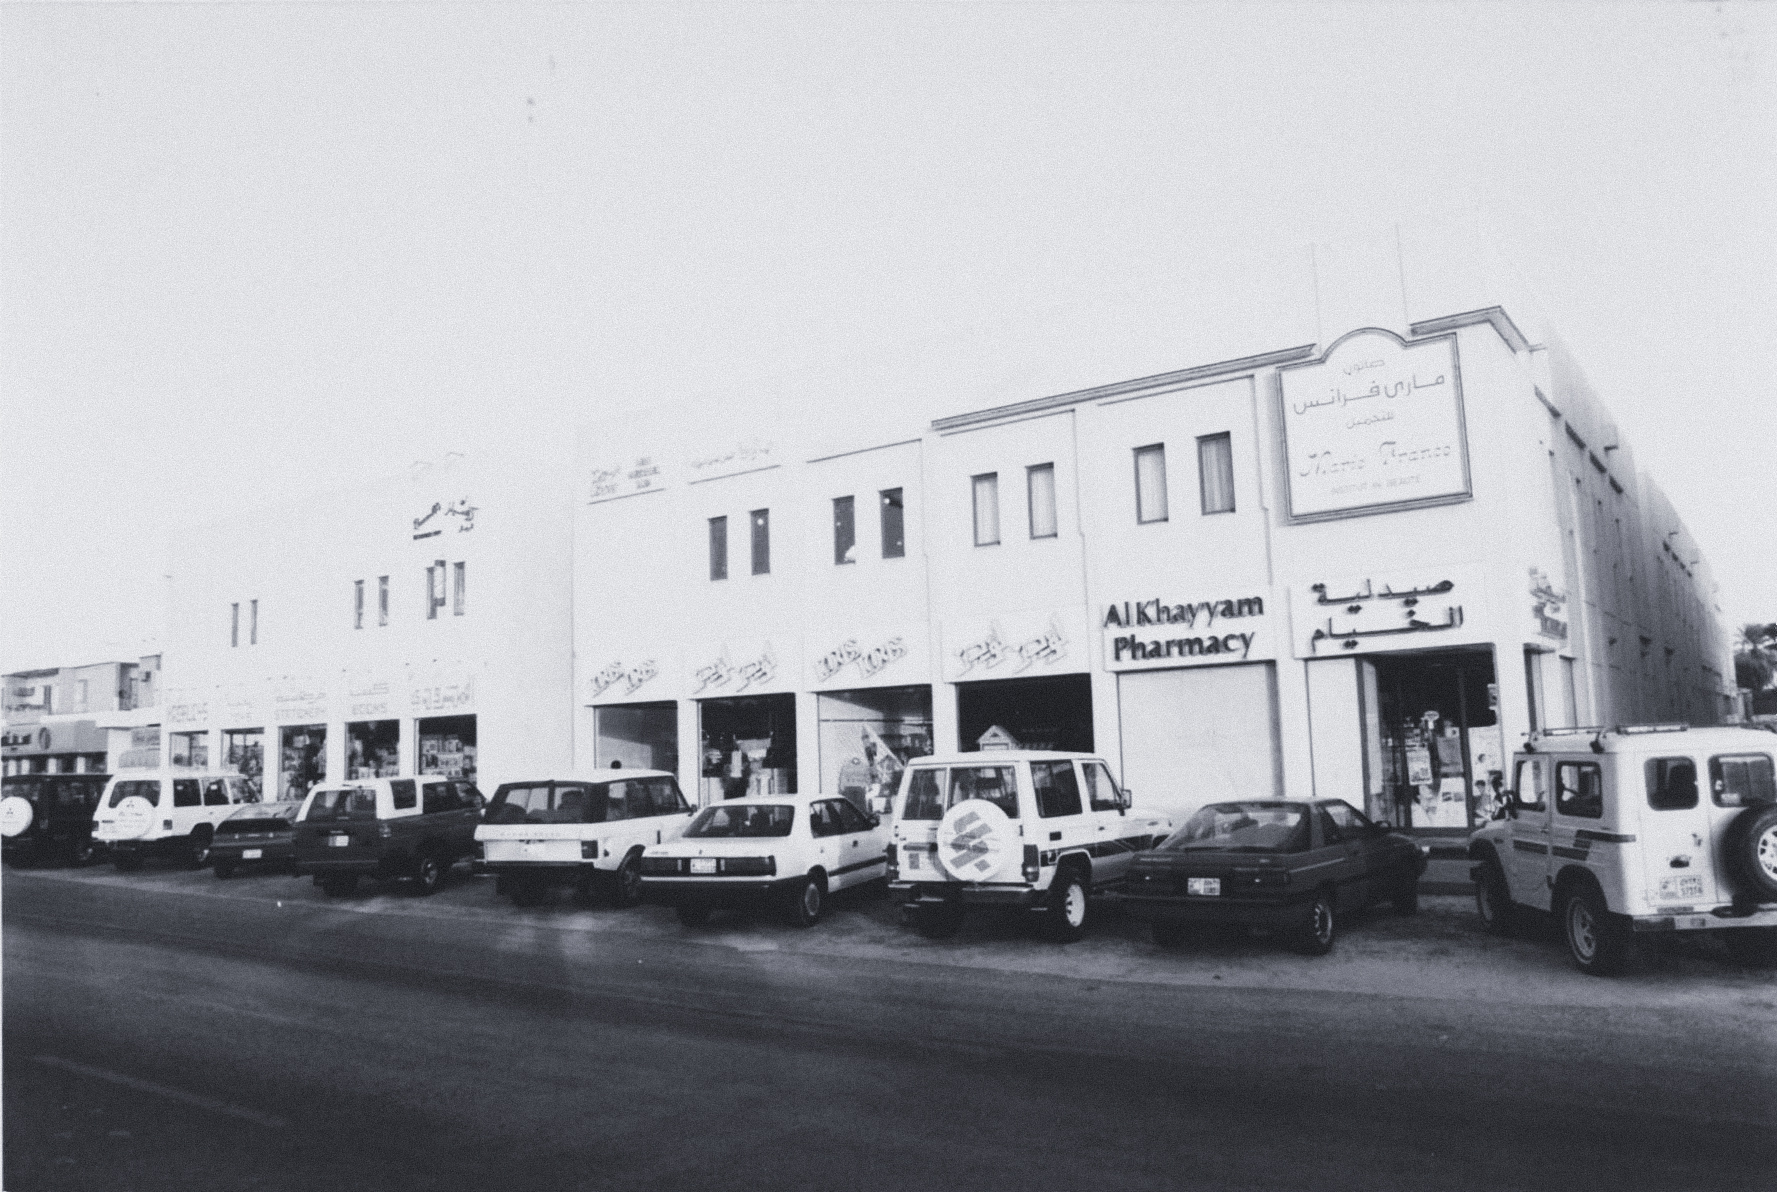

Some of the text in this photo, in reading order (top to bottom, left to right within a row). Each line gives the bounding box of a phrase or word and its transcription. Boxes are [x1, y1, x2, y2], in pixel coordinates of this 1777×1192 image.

[1293, 380, 1382, 415] فرانس
[1103, 596, 1264, 628] Al Khayyam
[1311, 578, 1454, 615] صيدلية
[1113, 631, 1255, 661] Pharmacy
[1310, 605, 1464, 654] الخيام
